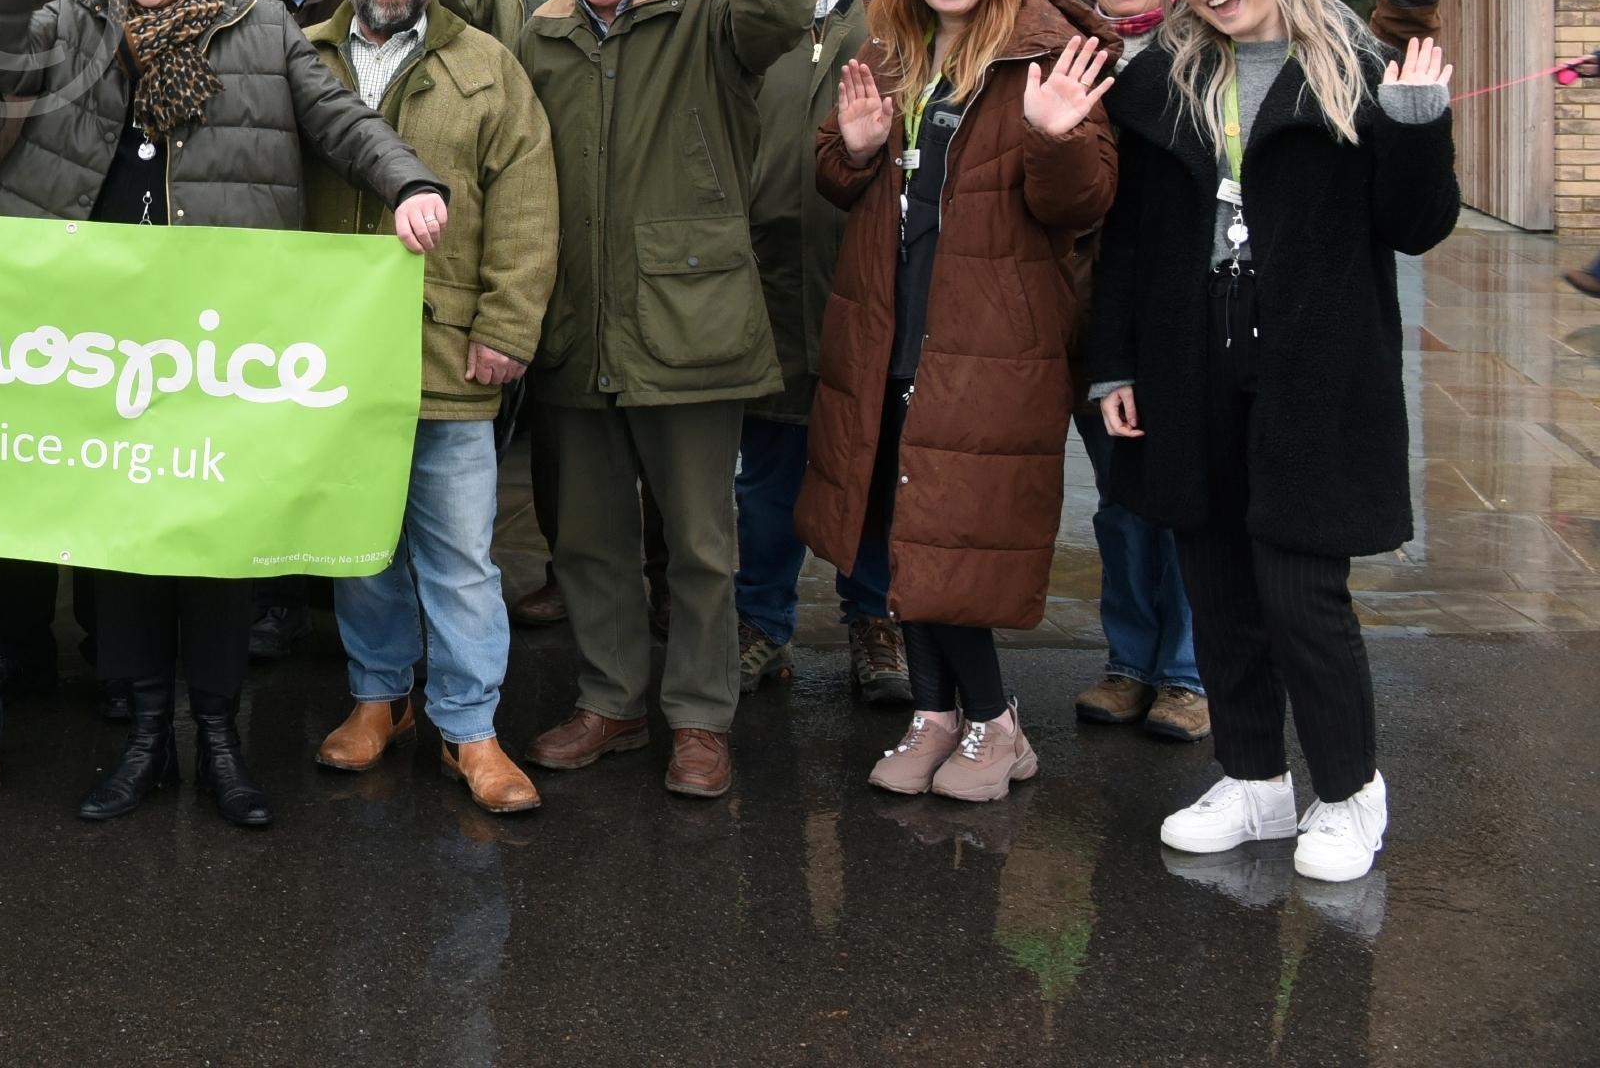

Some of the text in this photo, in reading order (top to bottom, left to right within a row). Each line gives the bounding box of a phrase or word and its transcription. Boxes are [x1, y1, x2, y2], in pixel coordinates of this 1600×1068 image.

[253, 553, 300, 565] Registered
[302, 553, 335, 565] Charity
[338, 555, 352, 564] No
